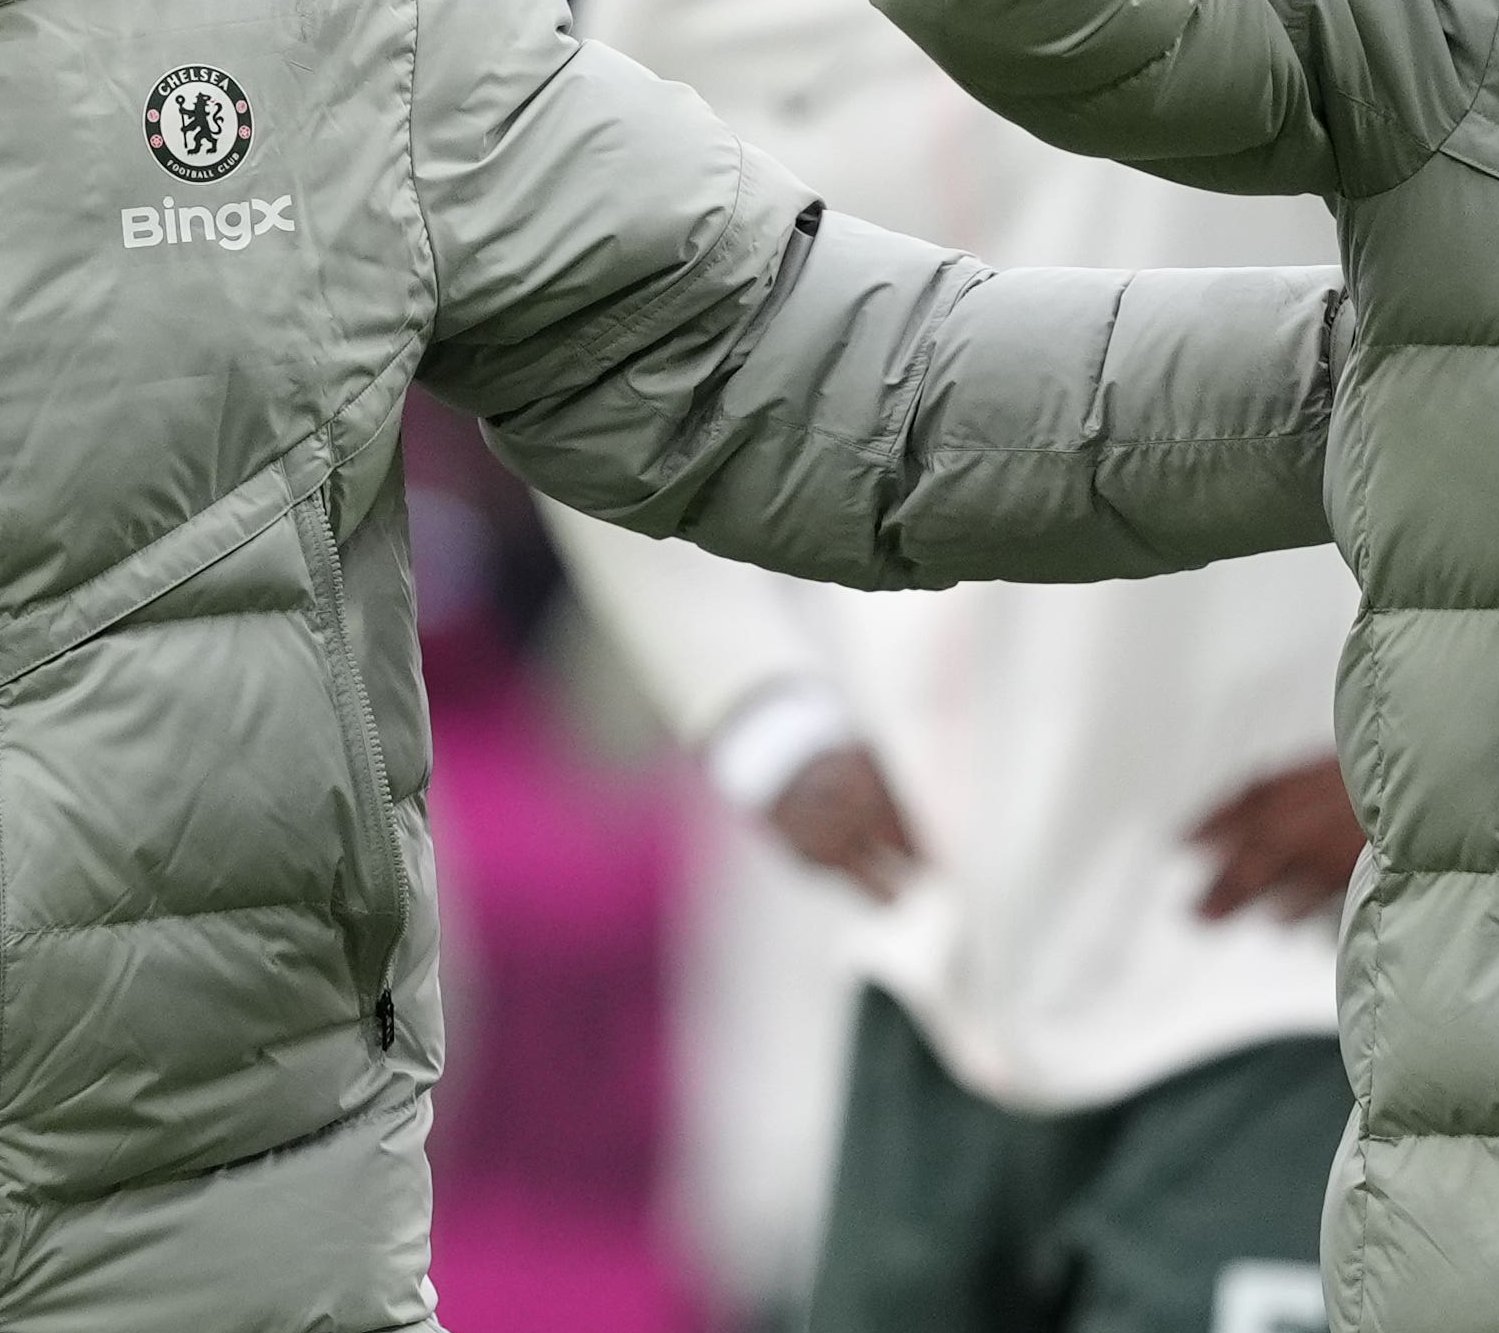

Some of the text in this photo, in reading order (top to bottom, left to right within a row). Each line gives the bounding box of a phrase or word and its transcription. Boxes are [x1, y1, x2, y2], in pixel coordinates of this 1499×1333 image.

[157, 68, 230, 97] CHELSEA
[166, 152, 240, 179] FOOTBALL CLUB
